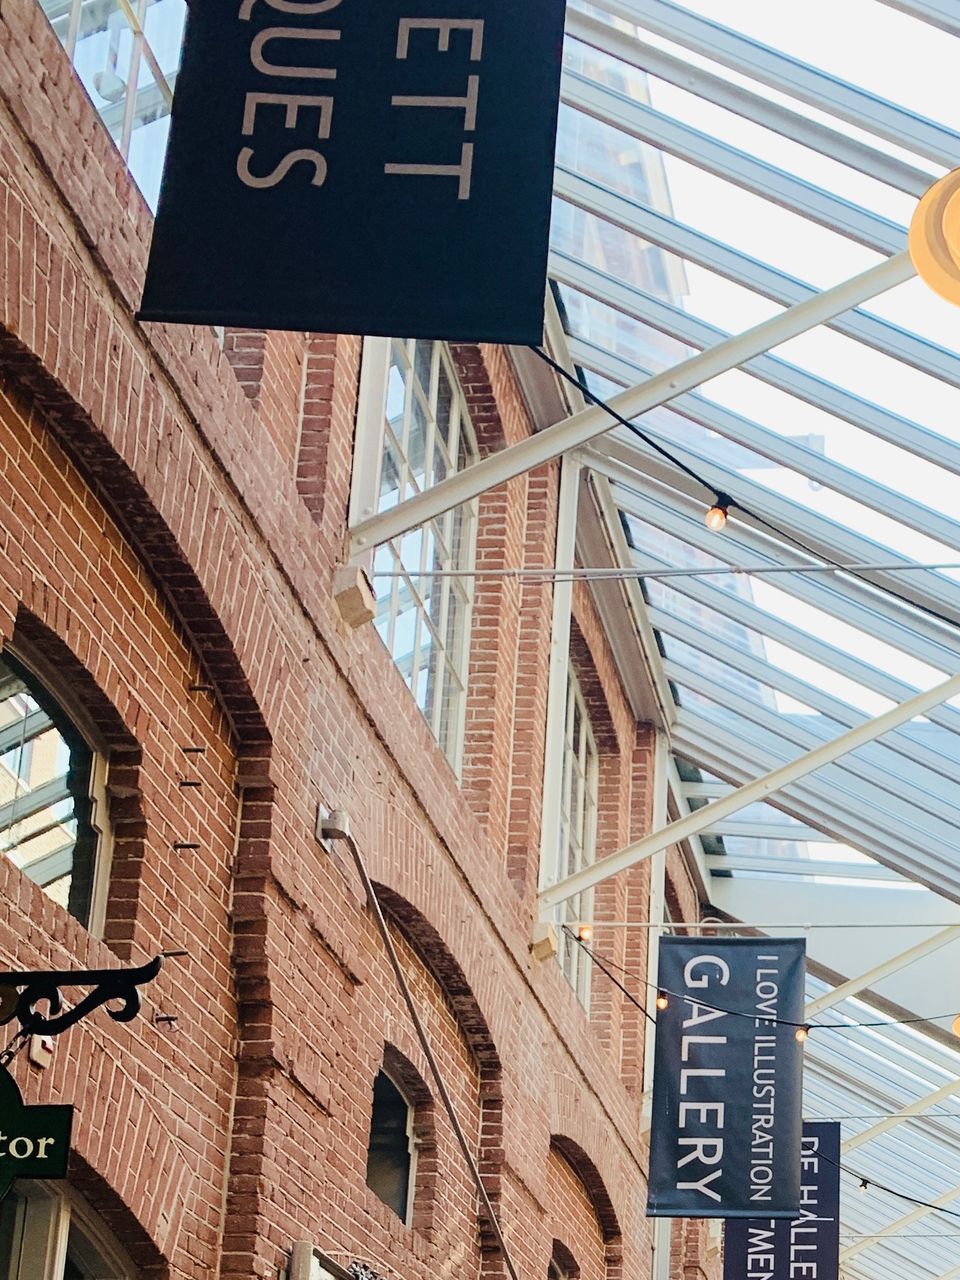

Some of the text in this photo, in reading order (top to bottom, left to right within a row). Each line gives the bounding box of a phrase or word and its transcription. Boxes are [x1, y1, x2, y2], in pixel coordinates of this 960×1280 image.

[675, 953, 731, 1203] GALLERY
[754, 968, 778, 1028] LOVE
[749, 1035, 777, 1201] ILLUSTRATION
